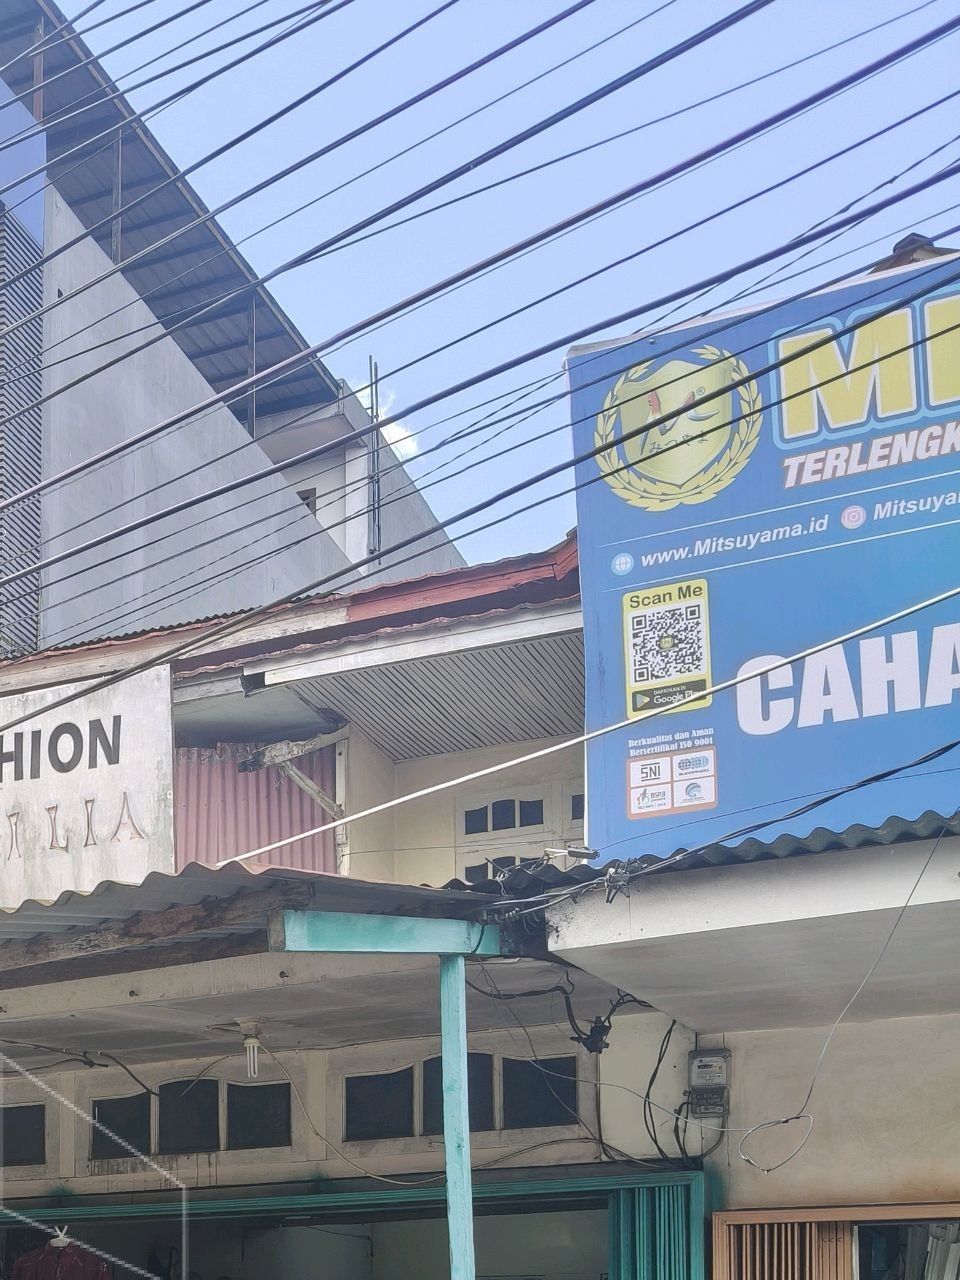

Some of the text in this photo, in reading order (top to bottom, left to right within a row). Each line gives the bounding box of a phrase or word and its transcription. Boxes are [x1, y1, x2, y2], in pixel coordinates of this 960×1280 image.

[873, 490, 960, 521] Mitsuya
[641, 515, 828, 568] www.Mitsuyama.id
[629, 585, 703, 609] Scan Me
[737, 622, 960, 735] CAHA
[653, 693, 684, 704] Google
[641, 764, 661, 779] SNI
[45, 791, 145, 854] LIA
